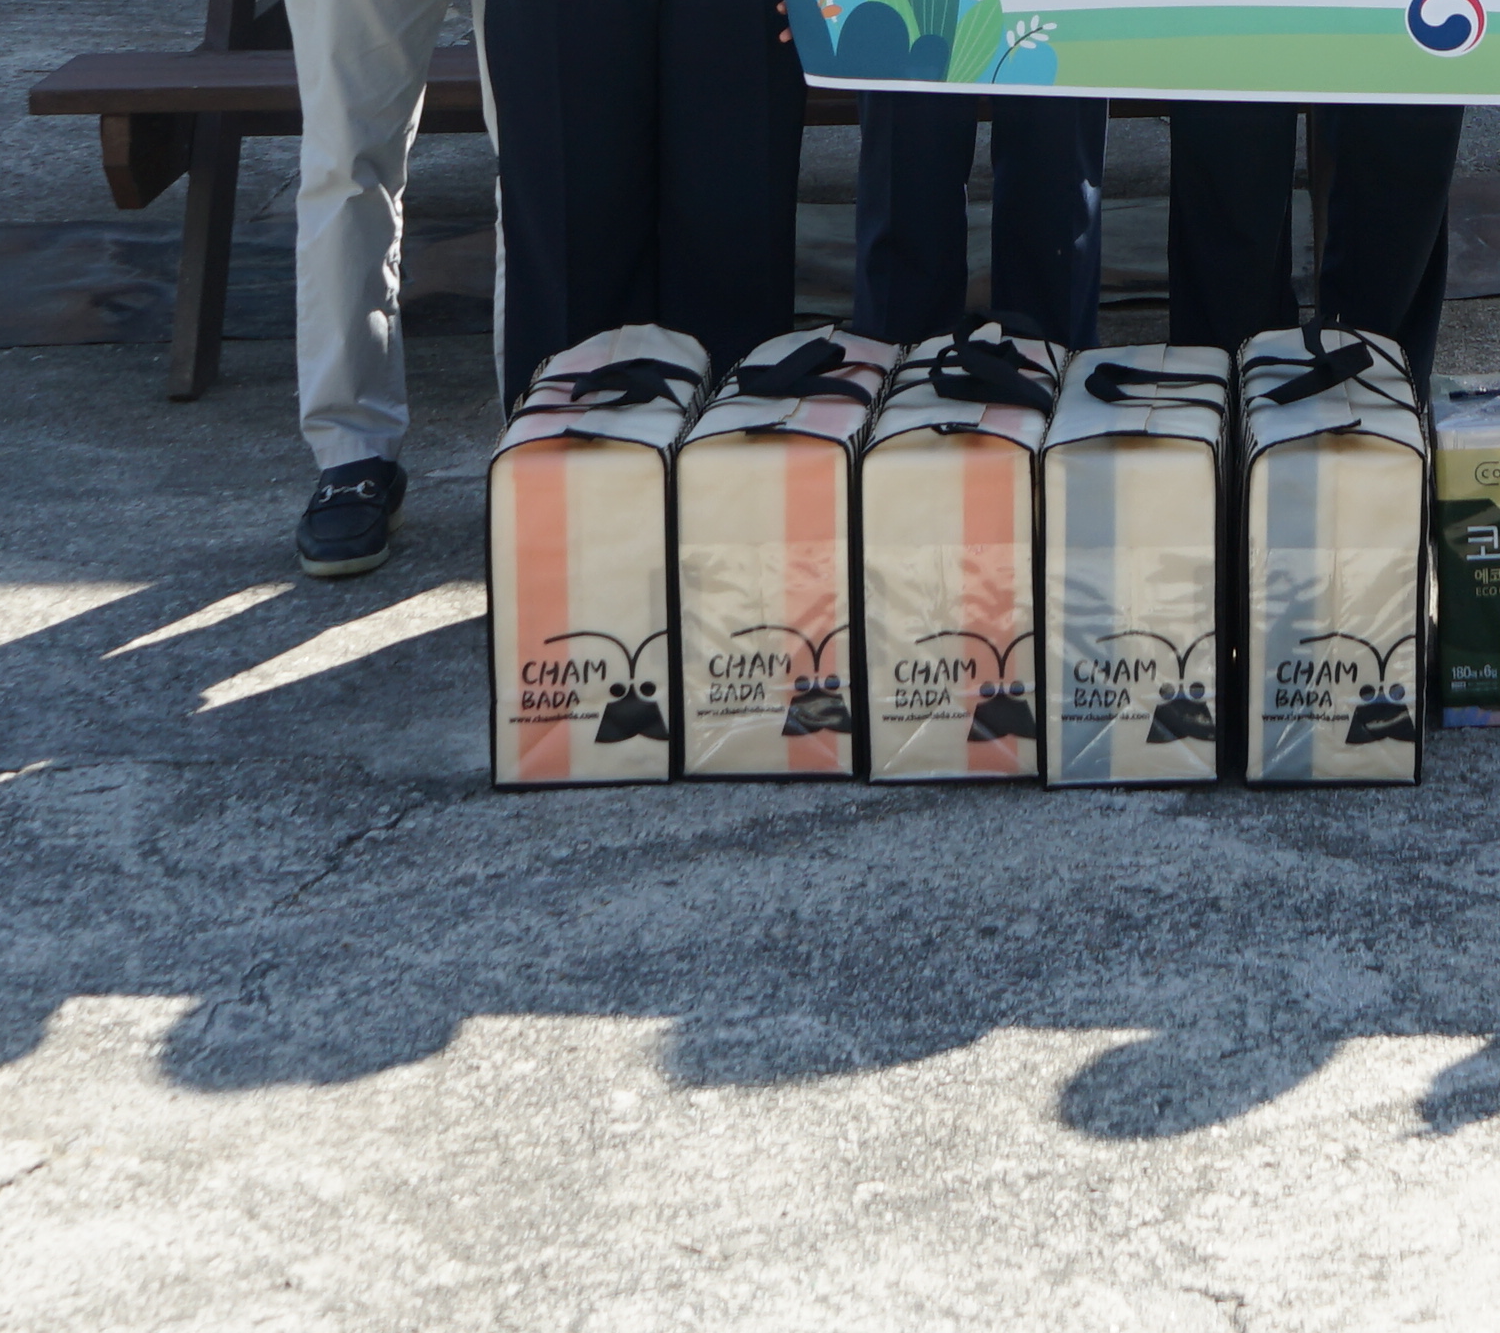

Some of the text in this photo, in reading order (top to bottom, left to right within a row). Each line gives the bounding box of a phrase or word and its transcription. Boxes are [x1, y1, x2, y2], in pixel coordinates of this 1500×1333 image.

[1475, 585, 1498, 596] ECO
[521, 659, 607, 685] CHAM
[708, 653, 792, 678] CHAM
[894, 657, 978, 684] CHAM
[1073, 658, 1157, 684] CHAM
[1276, 659, 1358, 685] CHAM
[521, 689, 580, 710] BADA
[709, 683, 767, 703] BADA
[894, 687, 951, 709] BADA
[1073, 688, 1131, 709] BADA
[1275, 688, 1333, 709] BADA
